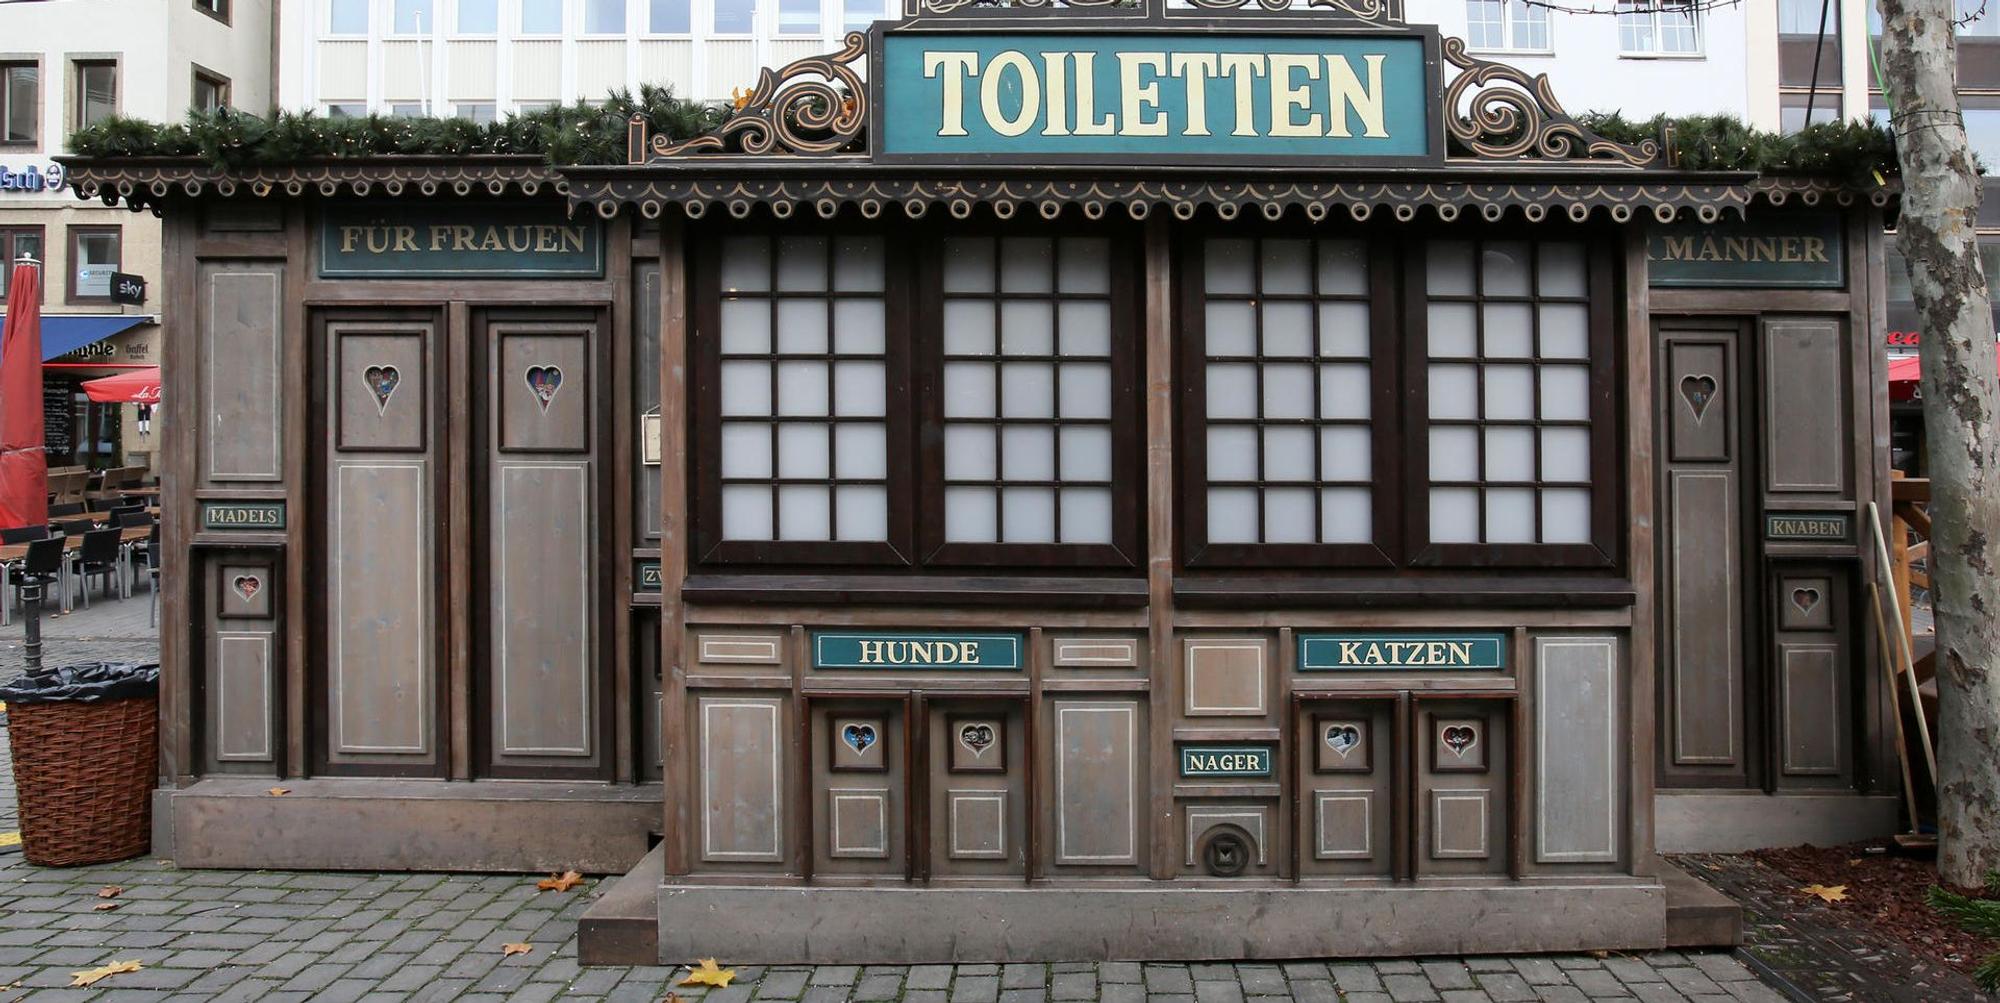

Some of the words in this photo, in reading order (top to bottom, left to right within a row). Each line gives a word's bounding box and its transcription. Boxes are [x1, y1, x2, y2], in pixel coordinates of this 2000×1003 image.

[922, 50, 1391, 138] TOILETTEN
[339, 219, 421, 253] FÜR
[428, 224, 587, 253] FRAUEN
[119, 280, 142, 298] sky
[1773, 520, 1841, 535] KNABEN
[859, 640, 980, 665] HUNDE
[1338, 642, 1474, 665] KATZEN
[1189, 754, 1261, 771] NAGER
